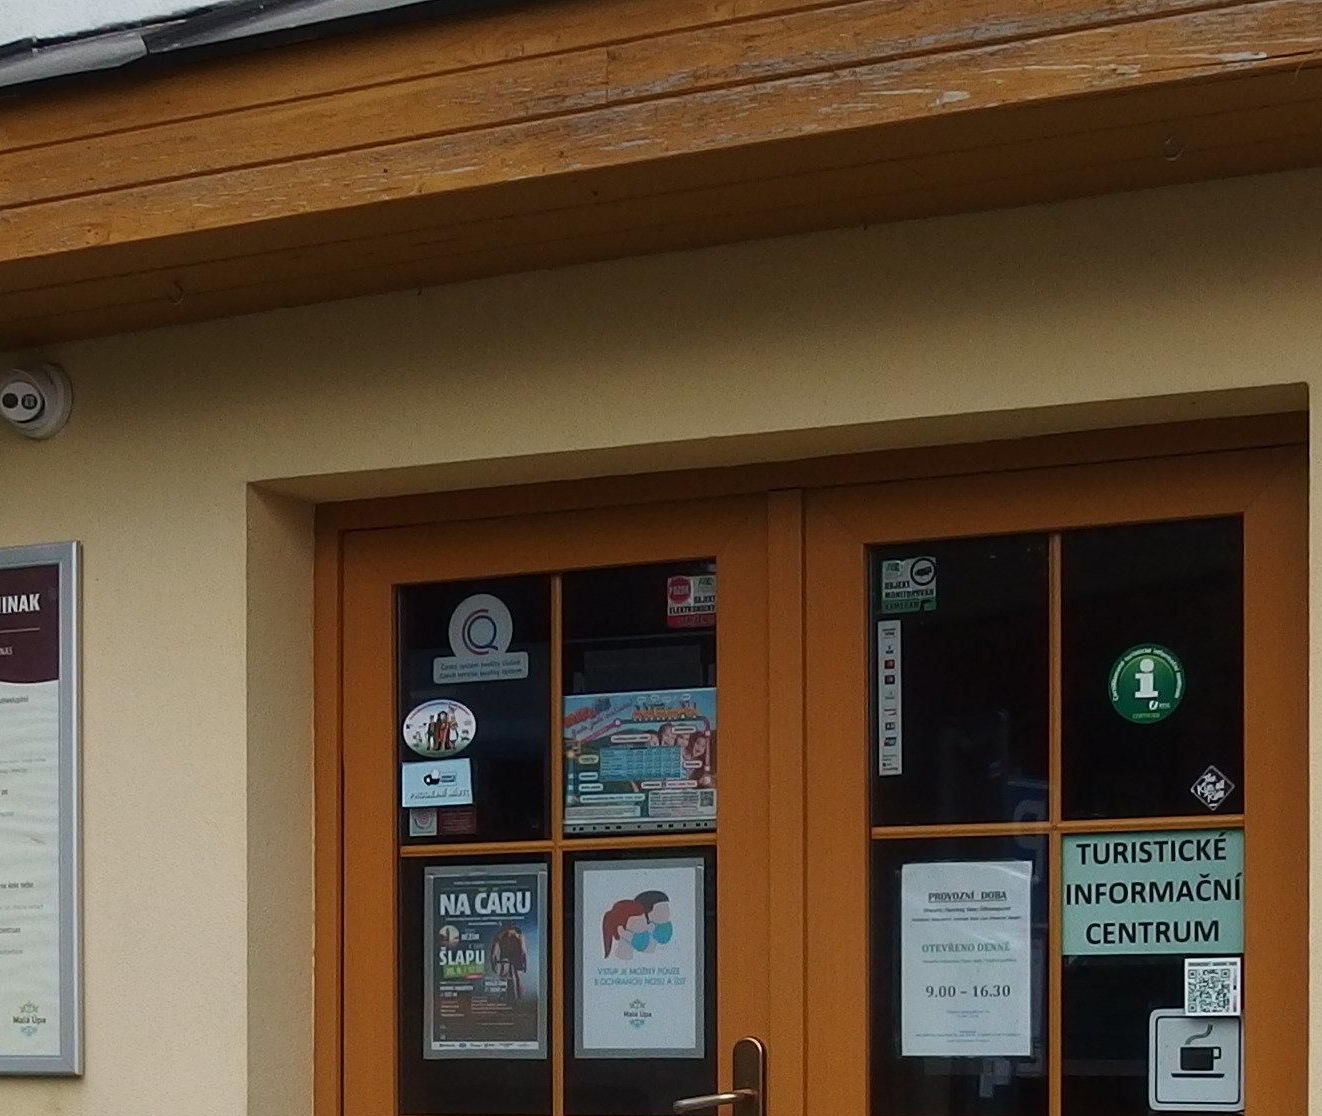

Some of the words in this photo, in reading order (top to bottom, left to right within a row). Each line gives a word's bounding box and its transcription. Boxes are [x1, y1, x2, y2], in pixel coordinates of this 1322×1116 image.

[1076, 832, 1227, 866] TURISTICKÉ
[928, 891, 974, 900] PROVOZNÍ
[981, 891, 1006, 900] DOBA
[1065, 872, 1242, 906] INFORMAČNÍ
[440, 894, 471, 915] NA
[1086, 919, 1220, 945] CENTRUM
[439, 946, 485, 965] ŠLAPU
[922, 942, 974, 953] OTEVŘENO
[926, 986, 956, 997] 9.00
[973, 985, 1010, 997] 16.30
